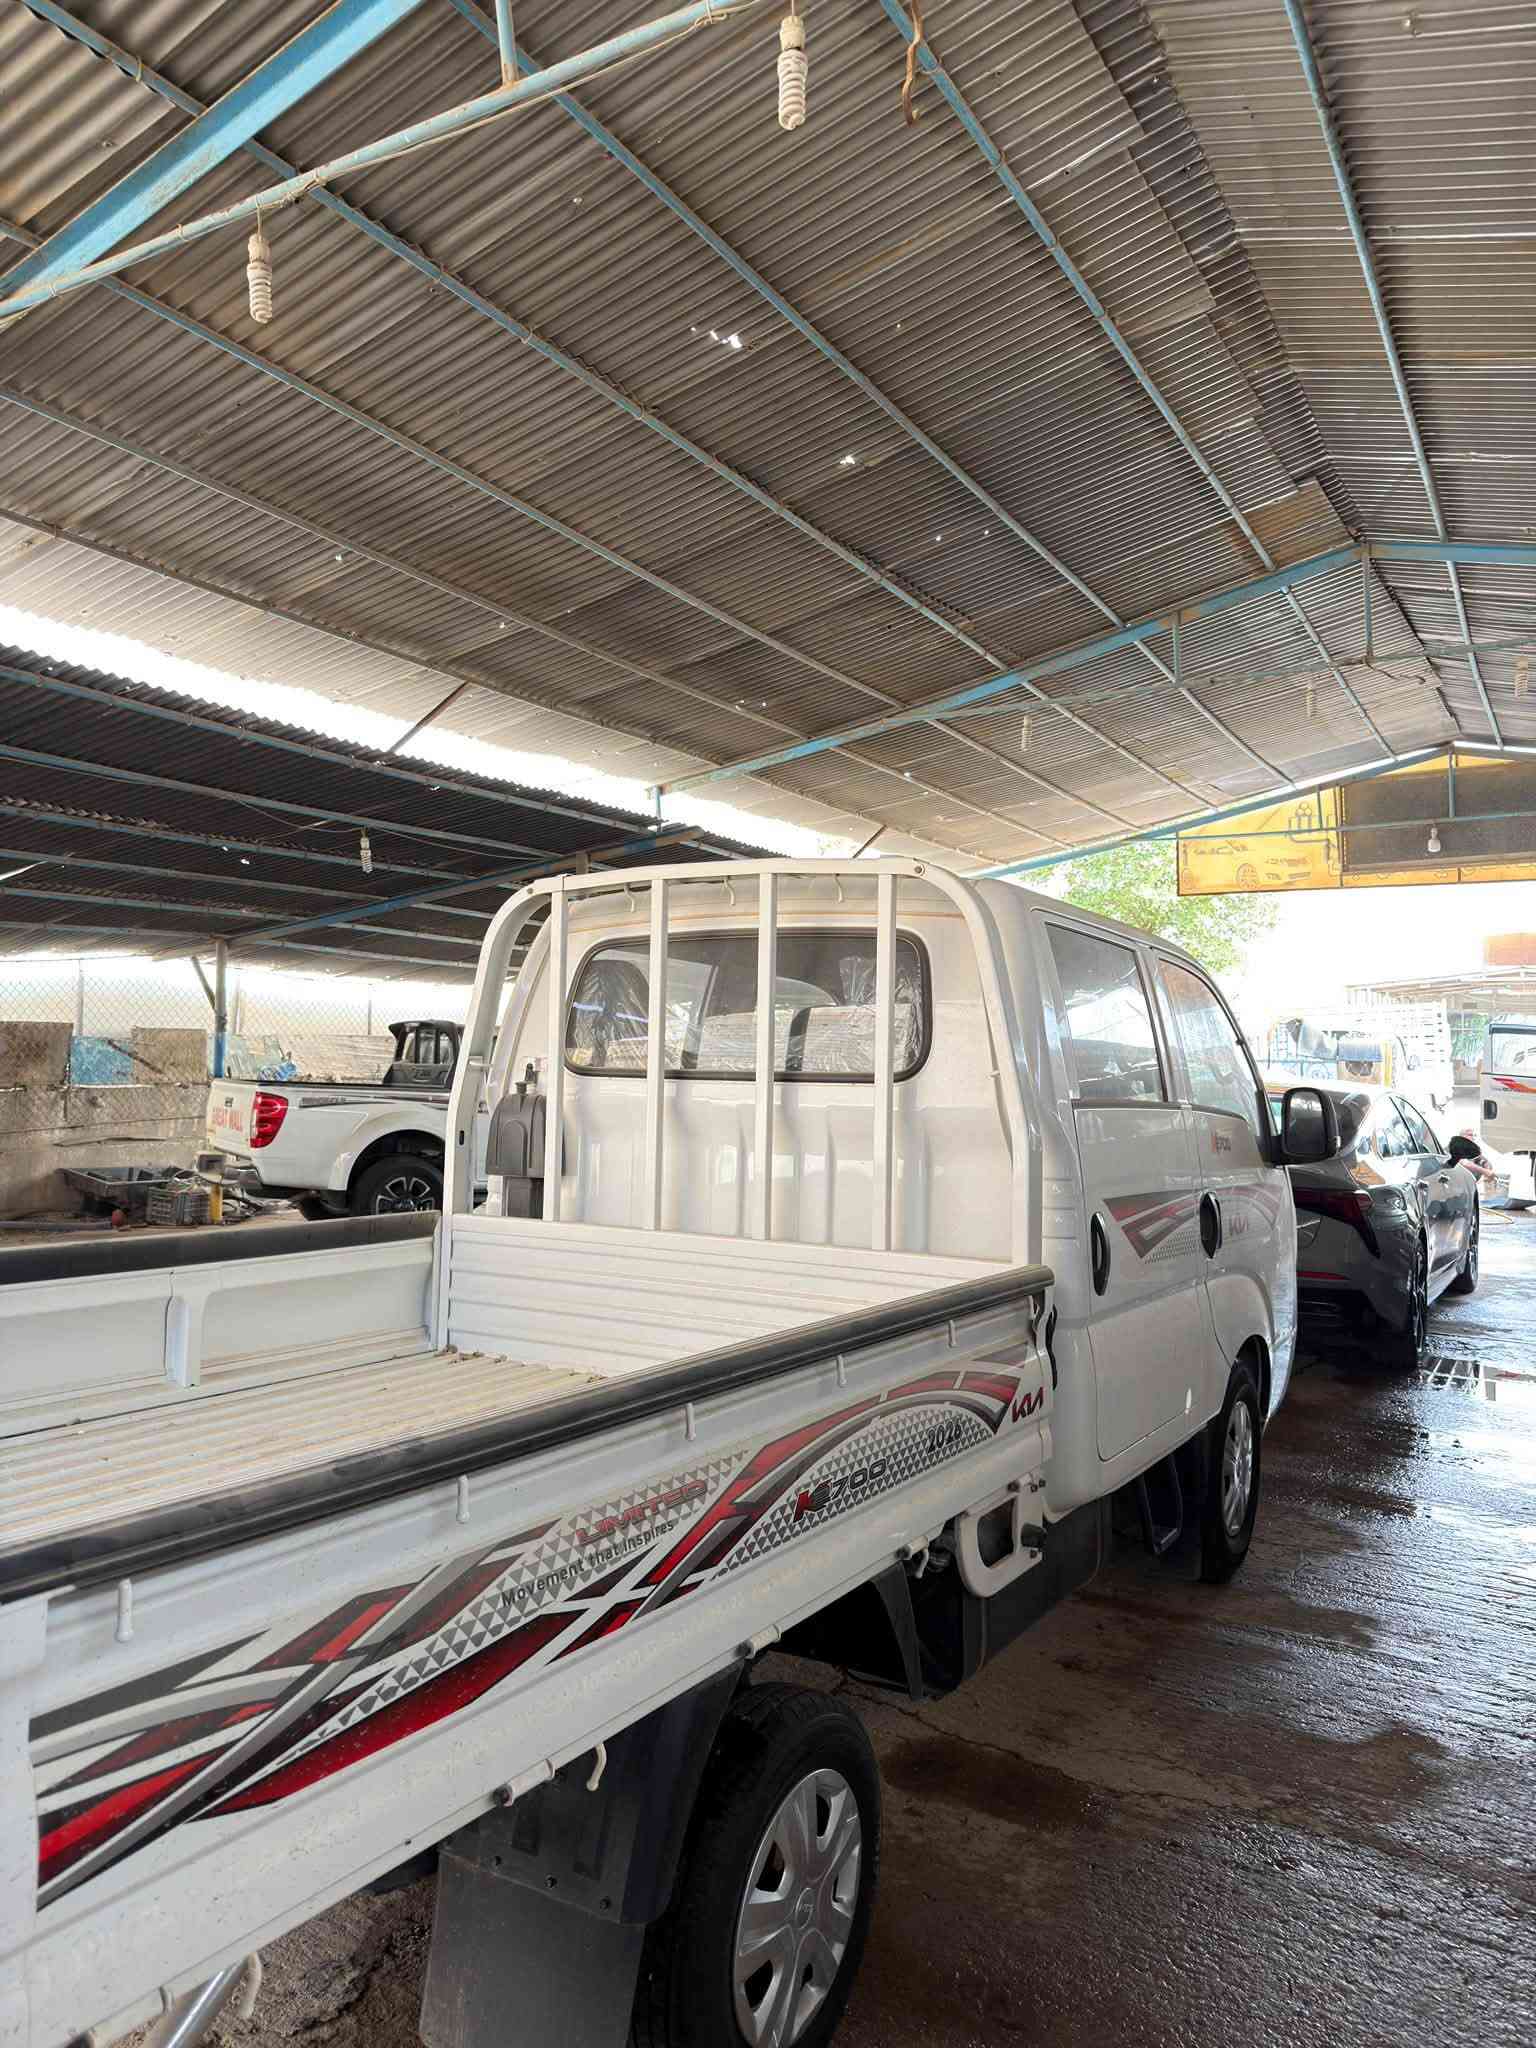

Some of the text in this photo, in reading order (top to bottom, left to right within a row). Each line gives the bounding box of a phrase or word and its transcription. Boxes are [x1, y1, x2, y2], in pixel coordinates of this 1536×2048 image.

[1012, 1386, 1043, 1422] KIA
[501, 1557, 585, 1607] Movement
[588, 1543, 620, 1568] that
